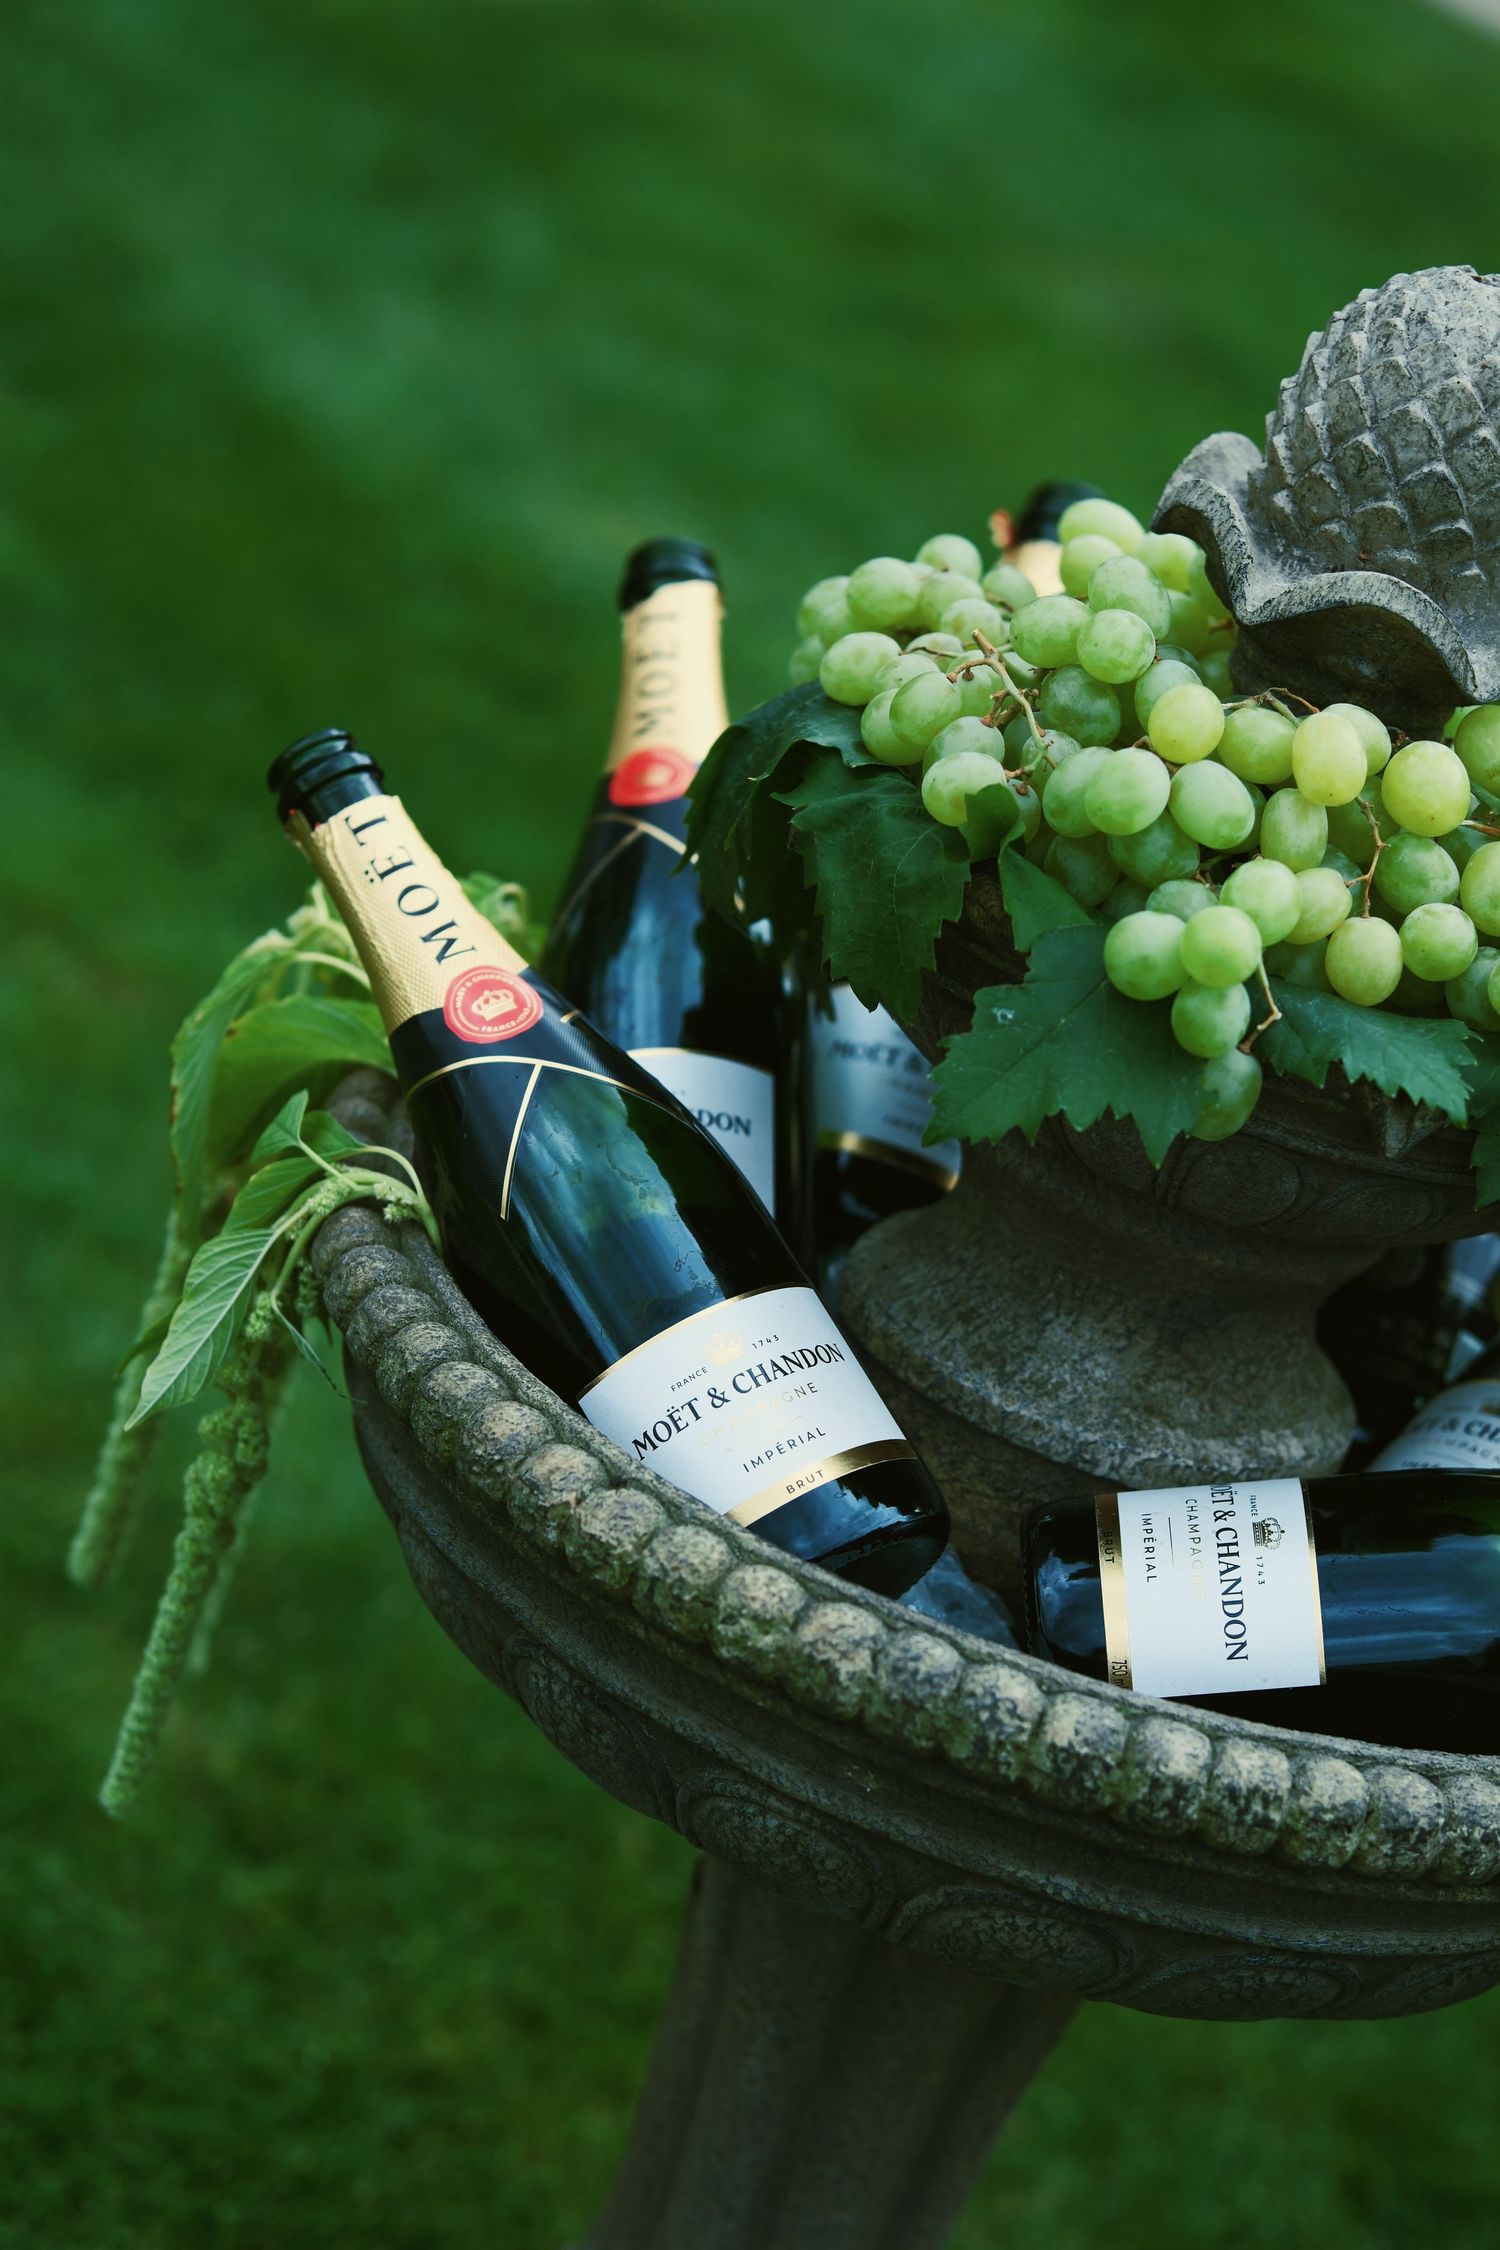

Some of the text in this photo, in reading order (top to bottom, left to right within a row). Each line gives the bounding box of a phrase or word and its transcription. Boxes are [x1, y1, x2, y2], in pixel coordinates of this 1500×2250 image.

[345, 814, 477, 965] MOËT
[690, 1108, 751, 1137] DON
[752, 1334, 780, 1349] 1743
[670, 1366, 709, 1392] FRANCE
[631, 1343, 846, 1462] MOËT & CHANDON
[743, 1427, 827, 1473] IMPÉRIAL
[786, 1470, 825, 1495] BRUT
[1103, 1531, 1116, 1564] BRUT
[1141, 1512, 1158, 1583] IMPÉRIAL
[1249, 1494, 1266, 1585] FRANCE 1743
[1208, 1485, 1249, 1661] OËT & CHANDON
[1111, 1659, 1129, 1677] 750
